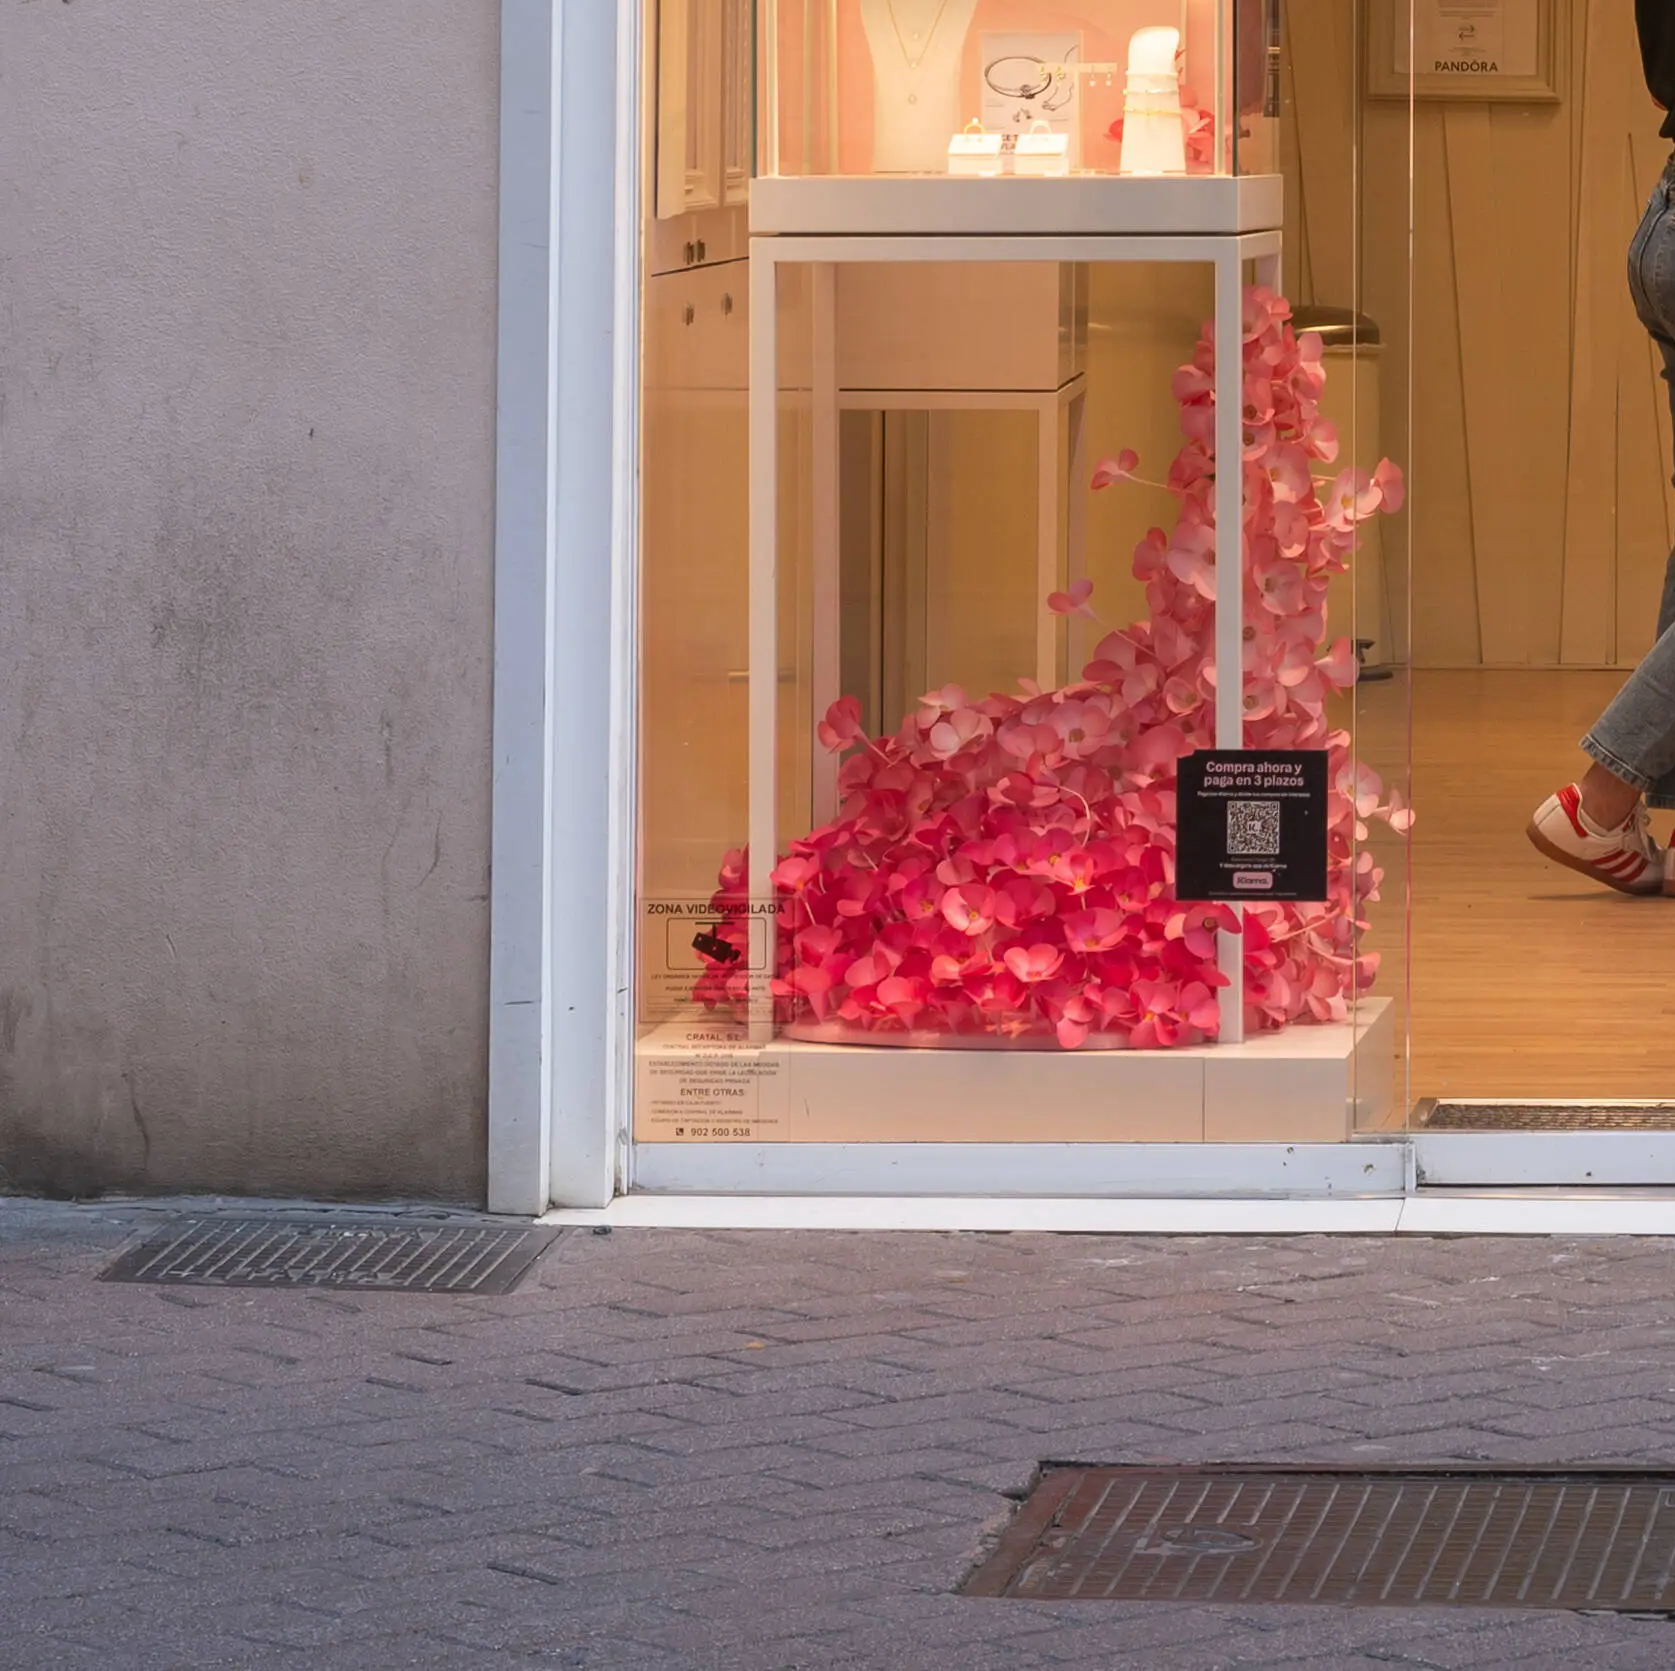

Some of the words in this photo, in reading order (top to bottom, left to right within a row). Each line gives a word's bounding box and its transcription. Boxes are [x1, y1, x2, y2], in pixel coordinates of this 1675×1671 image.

[1435, 59, 1498, 72] PANDORA
[1206, 761, 1254, 774] Compra
[1257, 762, 1292, 773] ahora
[1295, 764, 1302, 775] y
[1204, 776, 1233, 787] paga
[1236, 776, 1251, 785] en
[1254, 775, 1261, 785] 3
[1264, 775, 1304, 788] plazos
[647, 904, 683, 914] ZONA
[686, 904, 785, 914] VIDEOVIGILADA
[691, 1127, 708, 1136] 902
[712, 1127, 729, 1136] 500
[733, 1127, 750, 1136] 538
